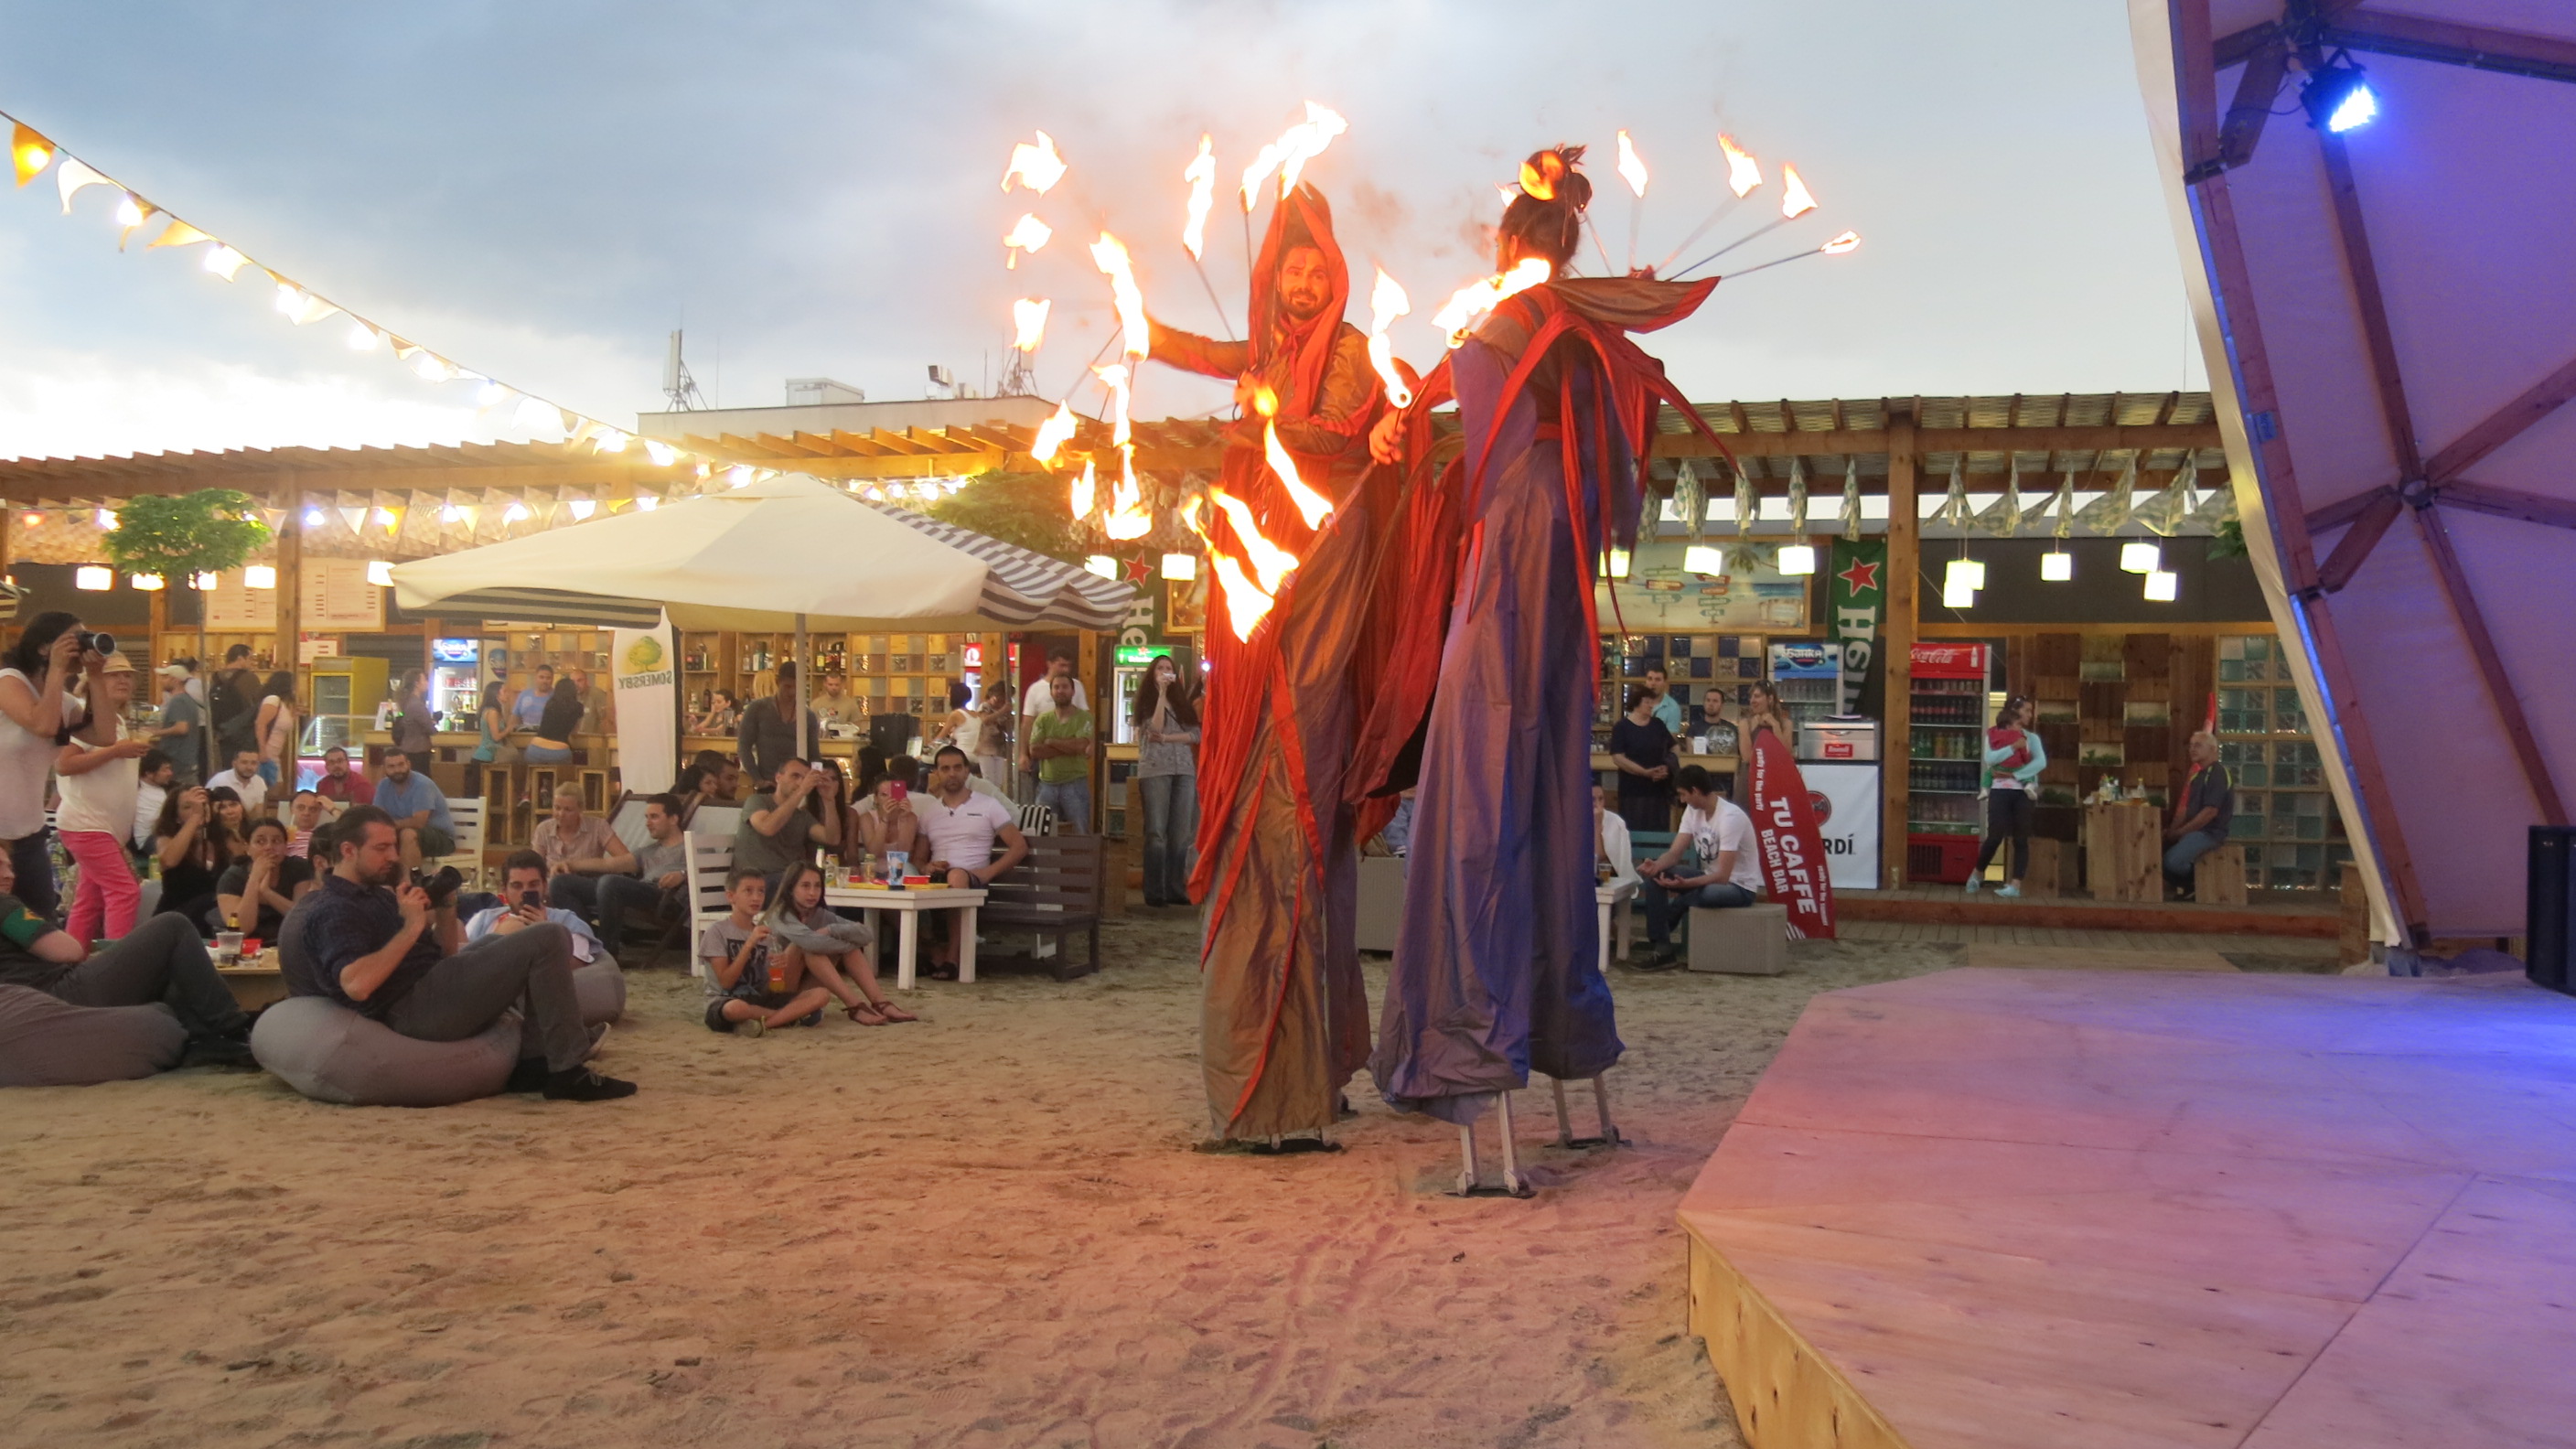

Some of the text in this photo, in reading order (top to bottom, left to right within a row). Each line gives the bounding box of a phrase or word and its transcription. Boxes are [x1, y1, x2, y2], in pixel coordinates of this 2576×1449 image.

[1754, 747, 1766, 811] ready for the party
[1761, 829, 1789, 894] BEACH BAR
[1769, 797, 1818, 915] TU CAFFE
